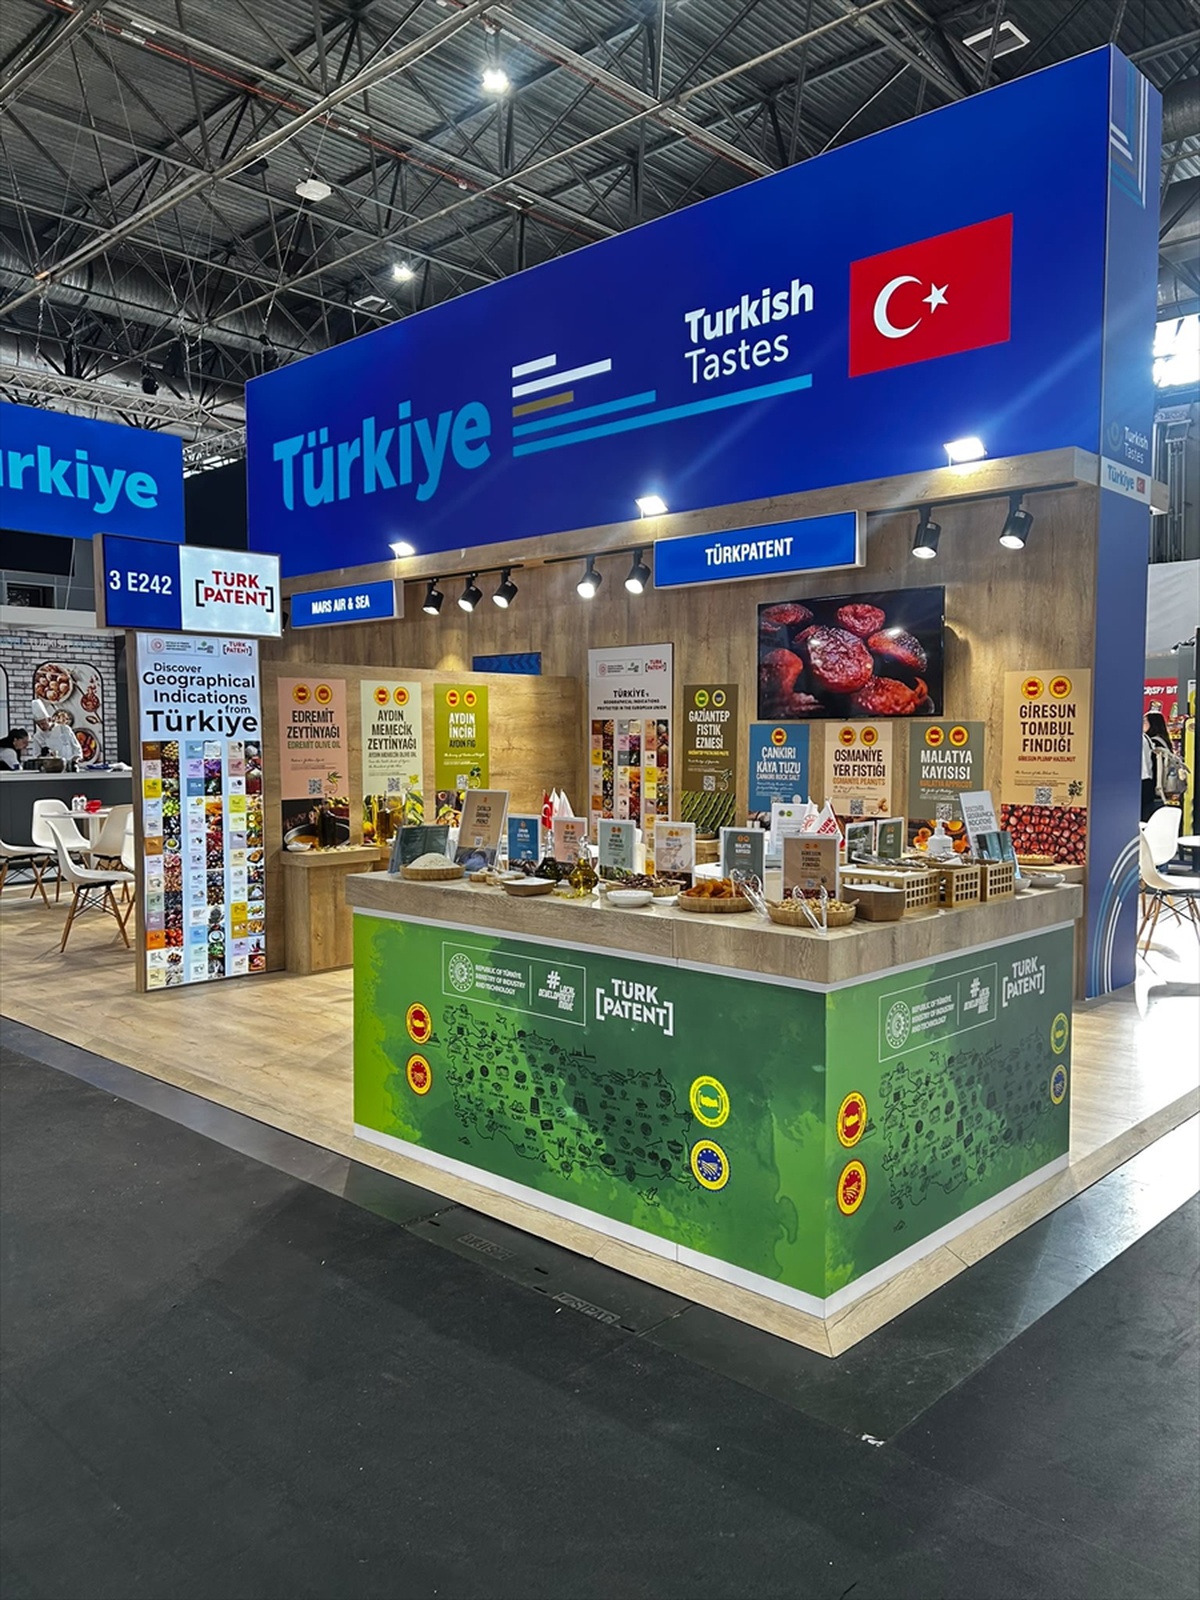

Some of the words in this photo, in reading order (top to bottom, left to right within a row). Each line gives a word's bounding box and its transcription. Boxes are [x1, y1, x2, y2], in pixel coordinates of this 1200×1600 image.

[684, 279, 813, 343] Turkish
[684, 334, 789, 384] Tastes
[1124, 426, 1148, 450] Turkish
[273, 400, 491, 511] Türkiye
[1124, 442, 1144, 464] Tastes
[0, 444, 158, 514] rkiye
[1107, 464, 1135, 491] Türkiye
[705, 537, 793, 566] TÜRKPATENT
[109, 570, 121, 590] 3
[127, 572, 172, 595] E242
[211, 570, 260, 589] TÜRK
[311, 600, 332, 615] MARS
[333, 598, 347, 612] AIR
[347, 597, 354, 610] &
[355, 595, 370, 609] SEA
[153, 662, 202, 673] Discover
[142, 671, 255, 690] Geographical
[153, 689, 248, 705] Indications
[224, 705, 251, 714] from
[292, 707, 335, 723] EDREMİT
[377, 709, 404, 721] AYDIN
[688, 708, 731, 723] GAZİANTEP
[1019, 701, 1077, 719] GİRESUN
[145, 709, 258, 738] Türkiye
[449, 712, 476, 725] AYDIN
[287, 723, 340, 739] ZEYTİNYAĞI
[371, 721, 413, 736] MEMECİK
[696, 724, 722, 736] FISTIK
[1020, 721, 1075, 736] TOMBUL
[314, 741, 331, 749] OLIVE
[331, 741, 341, 749] OIL
[367, 735, 417, 750] ZEYTİNYAĞI
[449, 739, 466, 748] AYDIN
[467, 739, 476, 748] FIG
[695, 735, 724, 749] EZMESİ
[1022, 736, 1071, 752] FINDIĞI
[761, 746, 797, 762] ÇANKIRI
[834, 746, 883, 762] OSMANİYE
[920, 749, 973, 764] MALATYA
[756, 761, 778, 773] KAYA
[778, 761, 801, 774] TUZU
[833, 764, 851, 777] YER
[852, 762, 886, 777] FISTIĞI
[922, 766, 970, 780] KAYISISI
[859, 777, 886, 786] PEANUTS
[475, 964, 497, 974] REPUBLIC
[475, 972, 496, 983] MINISTRY
[503, 979, 526, 989] INDUSTRY
[475, 981, 486, 989] AND
[486, 983, 516, 996] TECHNOLOGY
